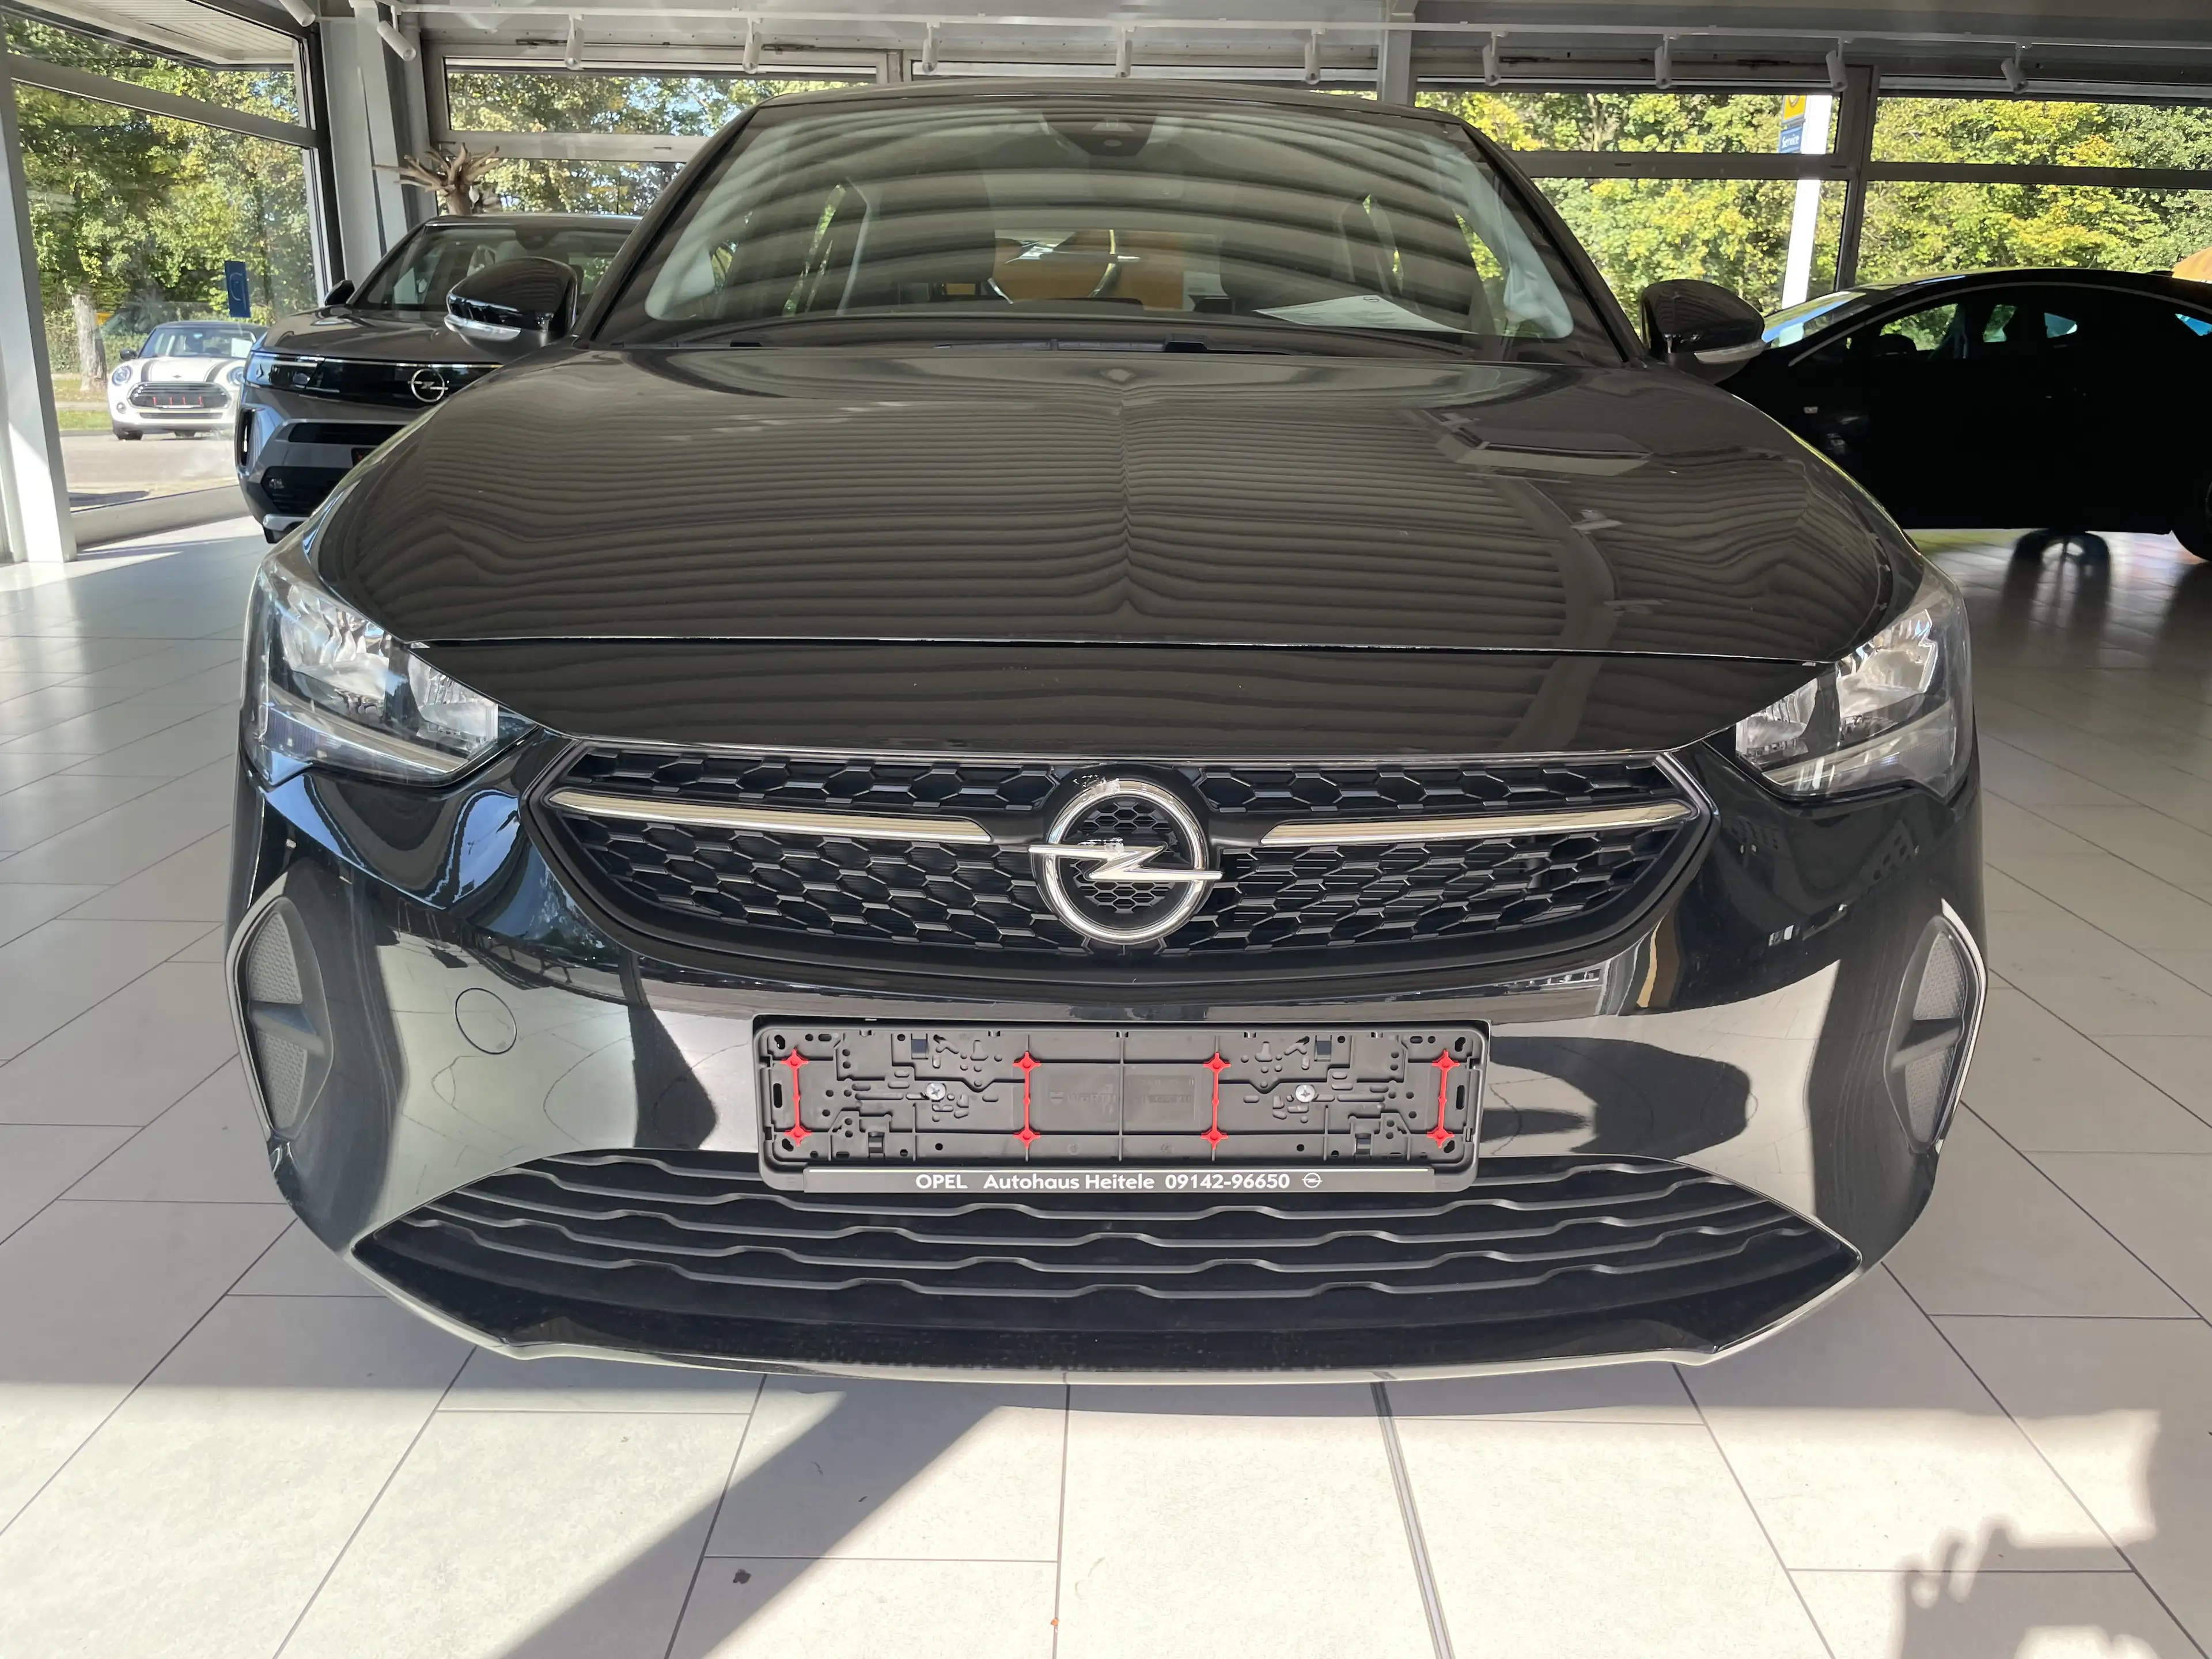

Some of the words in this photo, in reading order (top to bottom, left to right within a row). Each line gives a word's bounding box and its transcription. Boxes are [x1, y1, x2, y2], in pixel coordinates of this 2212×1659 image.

[1782, 134, 1800, 148] Service
[915, 1174, 968, 1189] OPEL
[983, 1173, 1080, 1189] Autohaus
[1085, 1173, 1154, 1189] Heitele
[1165, 1173, 1290, 1189] 09142-96650
